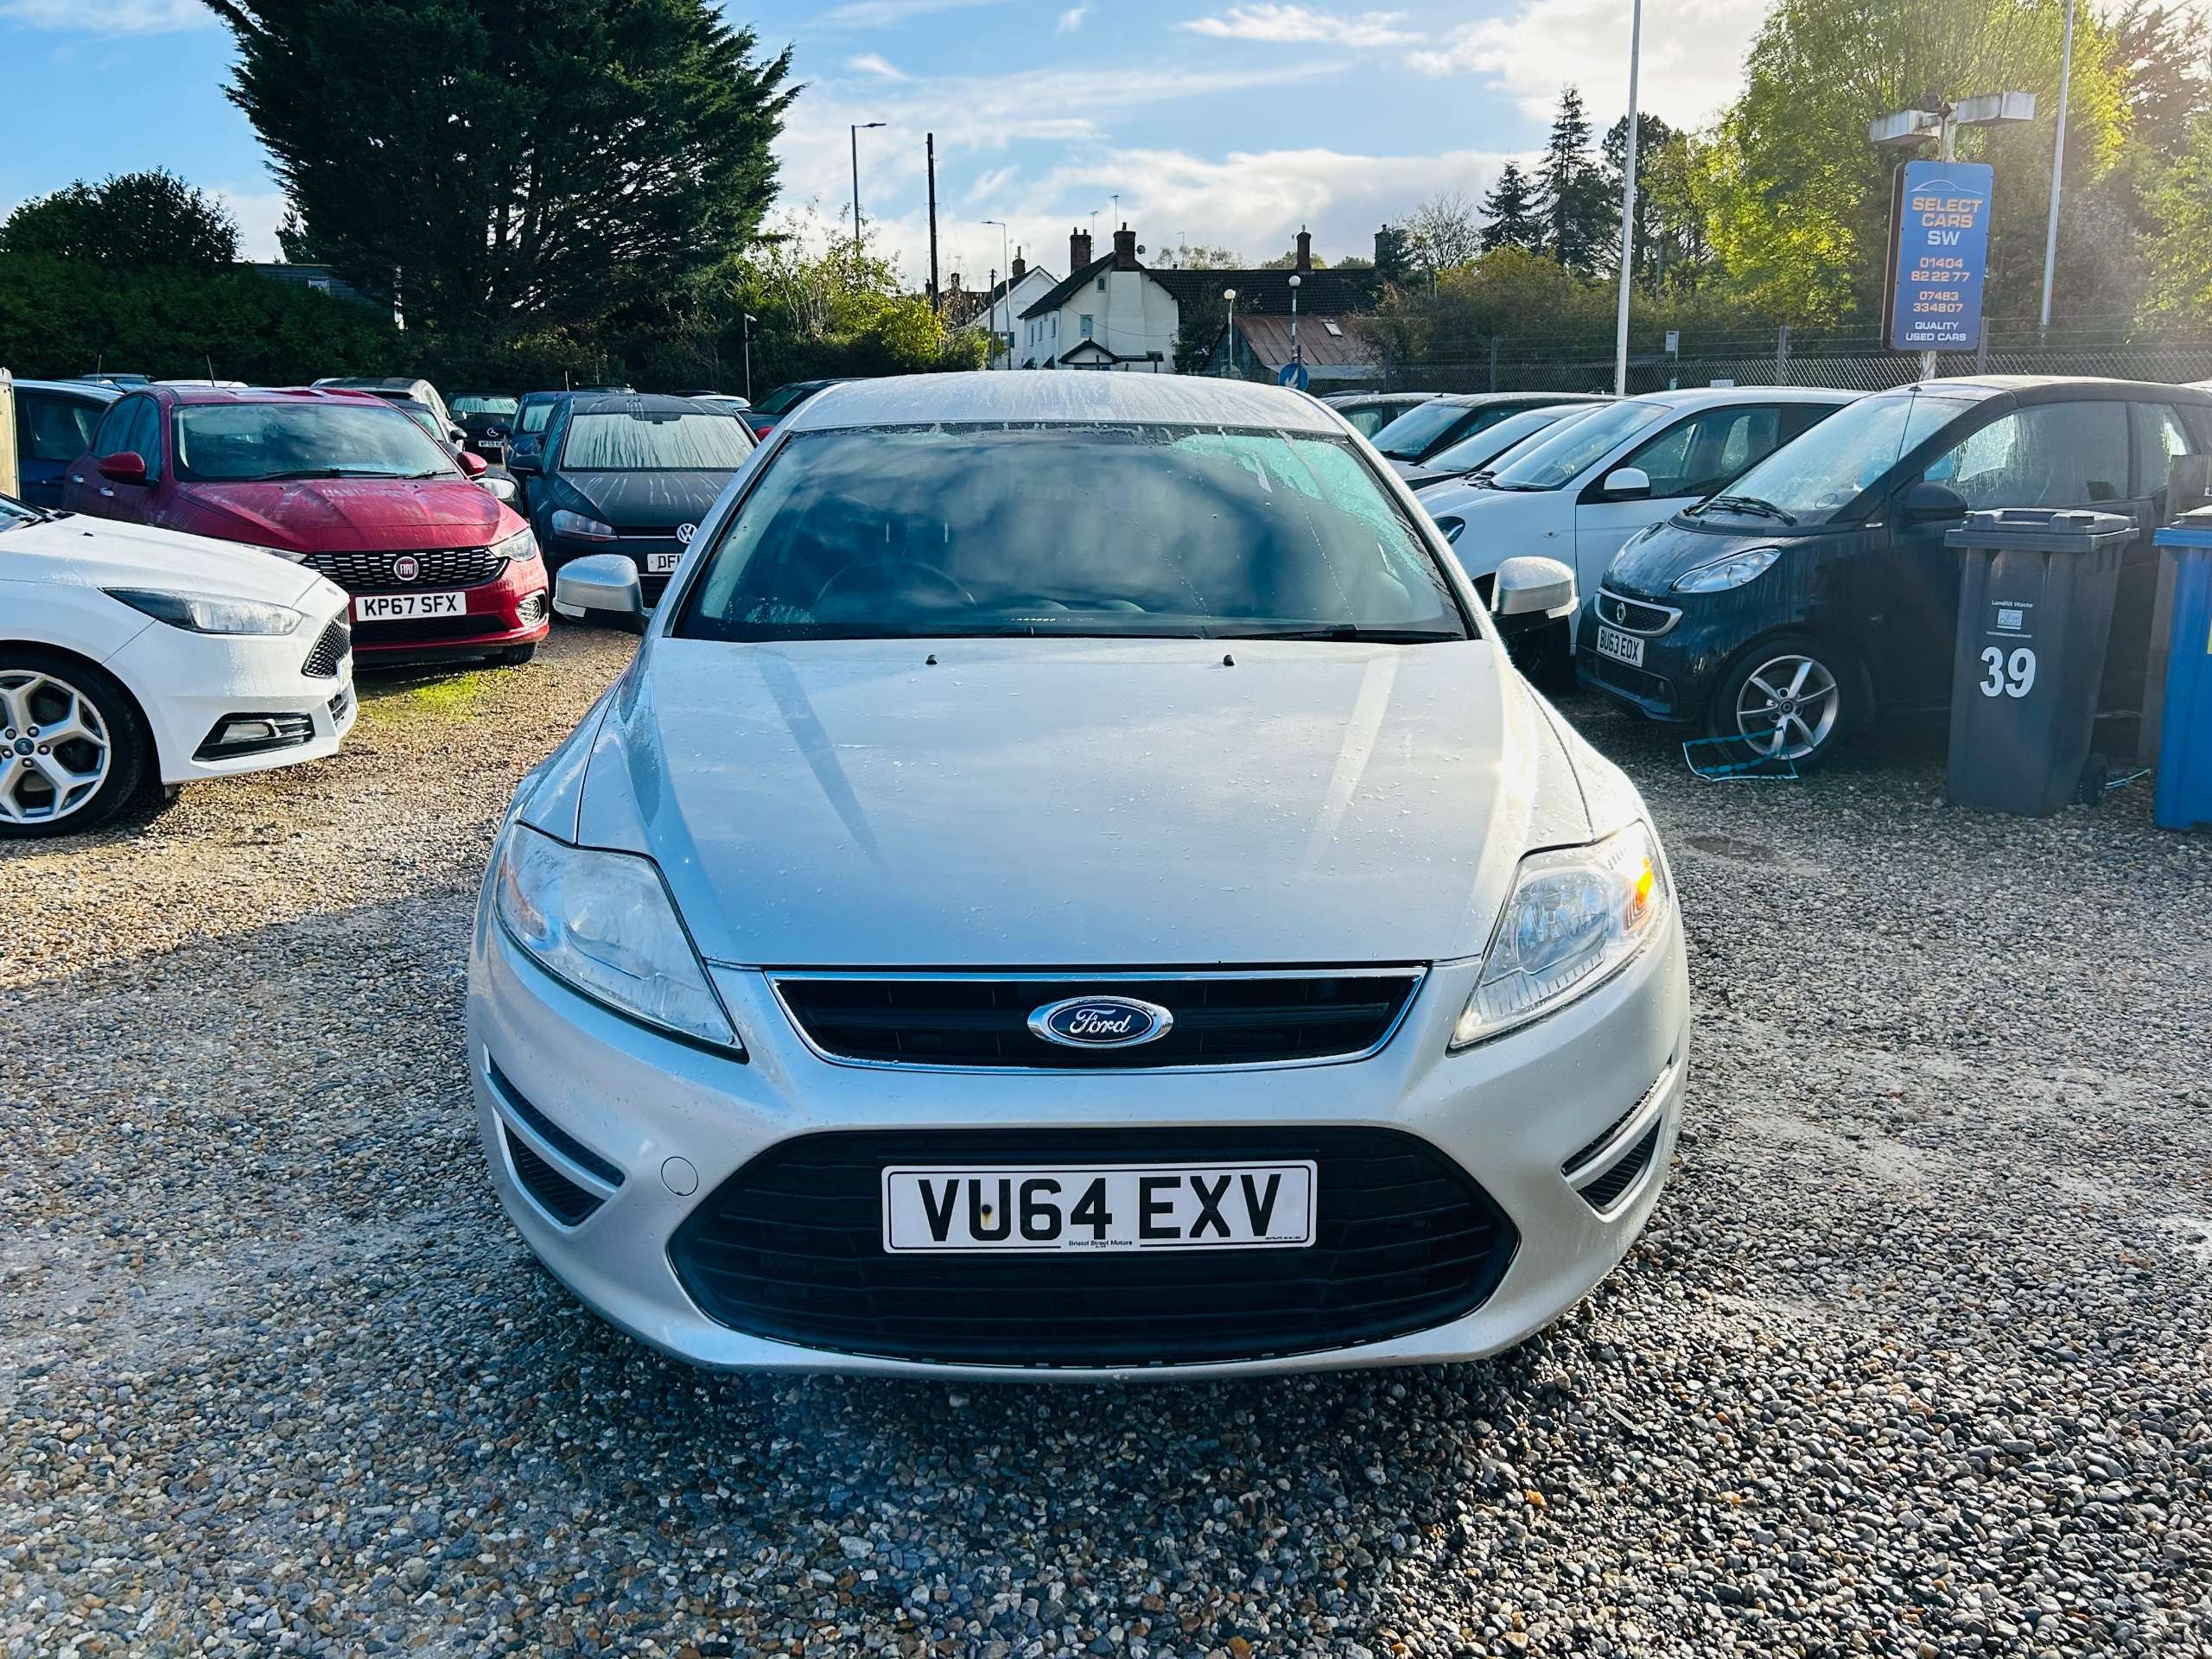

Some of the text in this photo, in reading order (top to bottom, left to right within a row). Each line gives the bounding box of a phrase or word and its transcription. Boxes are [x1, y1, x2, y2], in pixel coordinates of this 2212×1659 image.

[1912, 197, 1982, 213] SELECT
[1922, 213, 1974, 229] CARS
[1927, 230, 1961, 246] SW
[1920, 257, 1963, 269] 01404
[1919, 291, 1959, 301] 07483
[1912, 302, 1963, 313] 334807
[1915, 321, 1959, 330] QUALITY
[1905, 333, 1967, 341] USED CARS
[399, 563, 414, 575] FIAT
[658, 555, 683, 569] DF1
[364, 594, 457, 616] KP67 SFX
[1599, 629, 1640, 662] BU63 EOX
[1980, 646, 2037, 698] 39
[1069, 1008, 1133, 1034] Ford
[918, 1173, 1282, 1242] VU64 EXV
